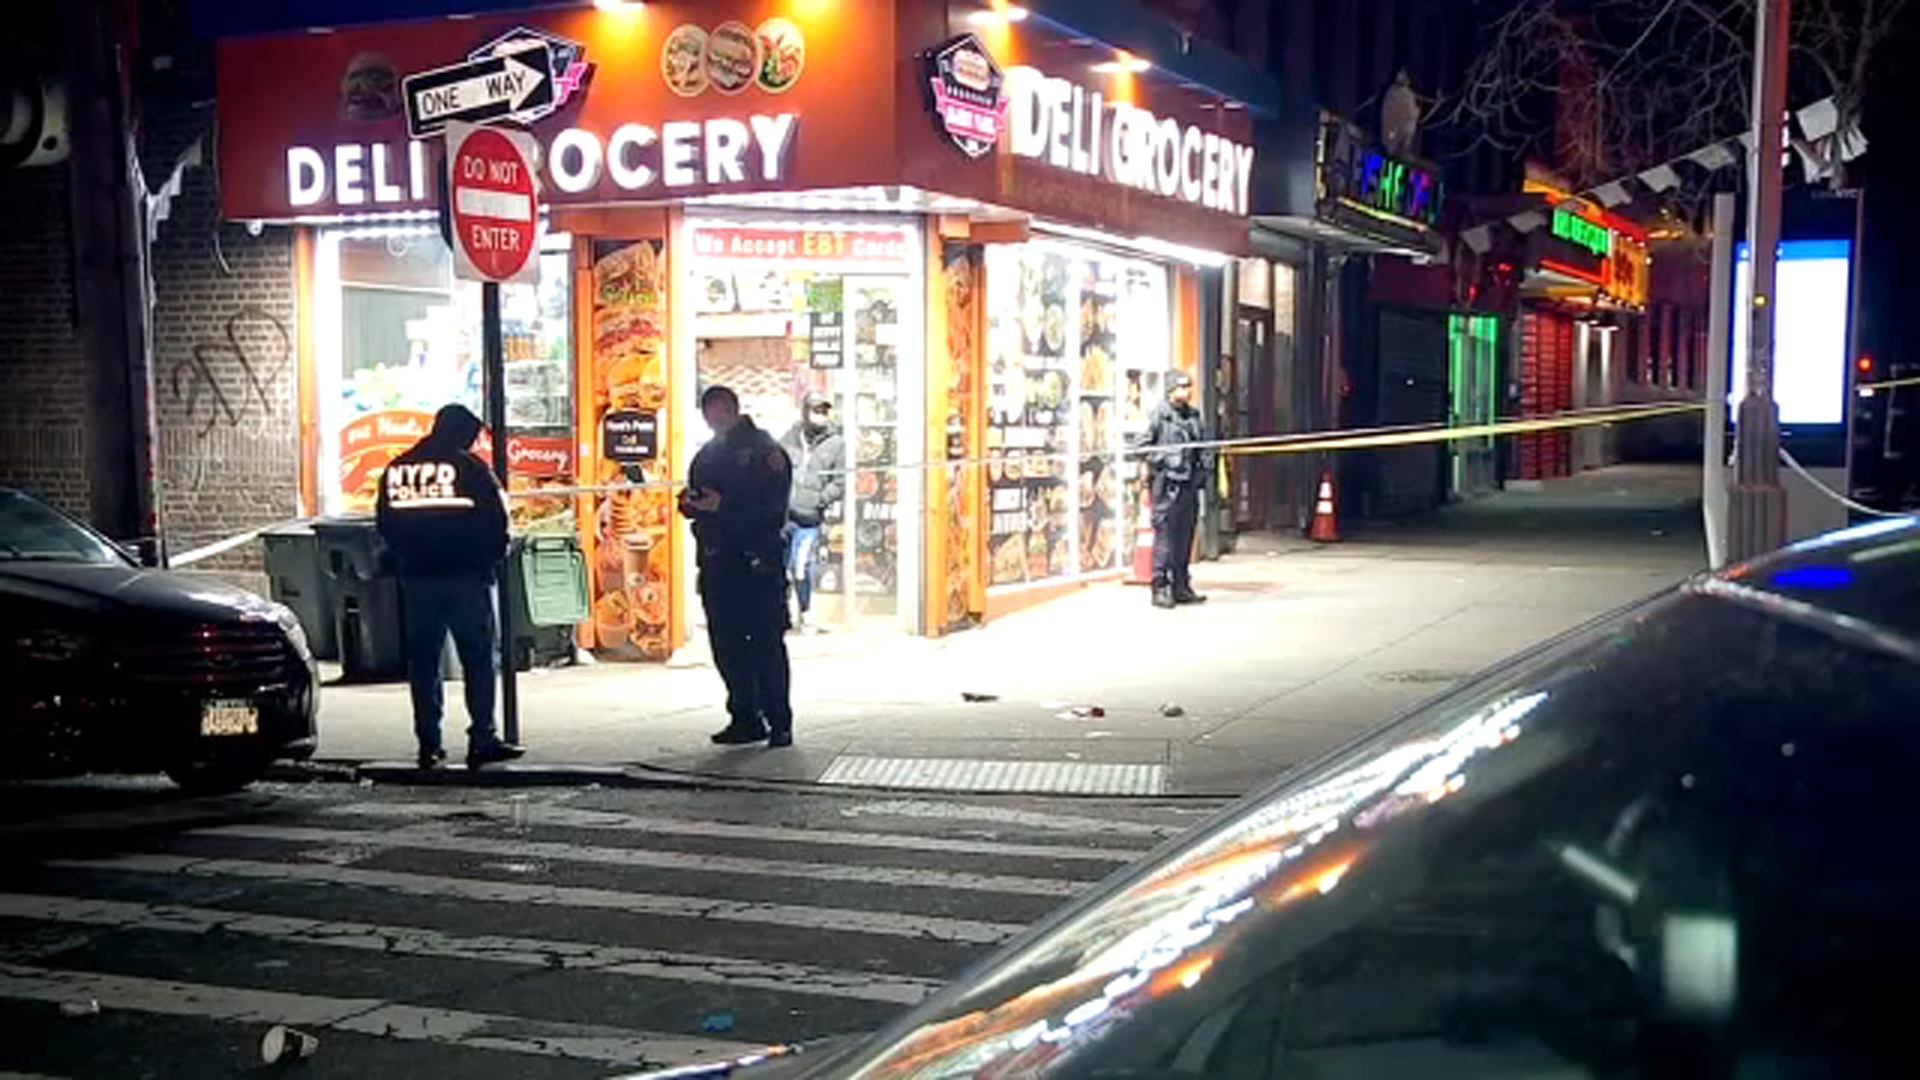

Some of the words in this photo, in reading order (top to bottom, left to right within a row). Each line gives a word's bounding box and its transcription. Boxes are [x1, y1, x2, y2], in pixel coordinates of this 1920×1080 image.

[421, 87, 460, 115] ONE
[486, 71, 526, 98] WAY
[1009, 65, 1101, 175] DELI
[1112, 105, 1254, 216] GROCERY
[287, 145, 425, 206] DELI
[531, 113, 798, 193] OCERY
[463, 156, 486, 180] DO
[489, 158, 519, 185] NOT
[471, 224, 520, 251] ENTER
[695, 233, 724, 254] We
[731, 236, 795, 258] Accept
[803, 232, 847, 255] EBT
[853, 238, 906, 256] Cards
[506, 438, 569, 472] Grocery
[386, 463, 456, 486] NYPD
[387, 483, 455, 500] POLICE
